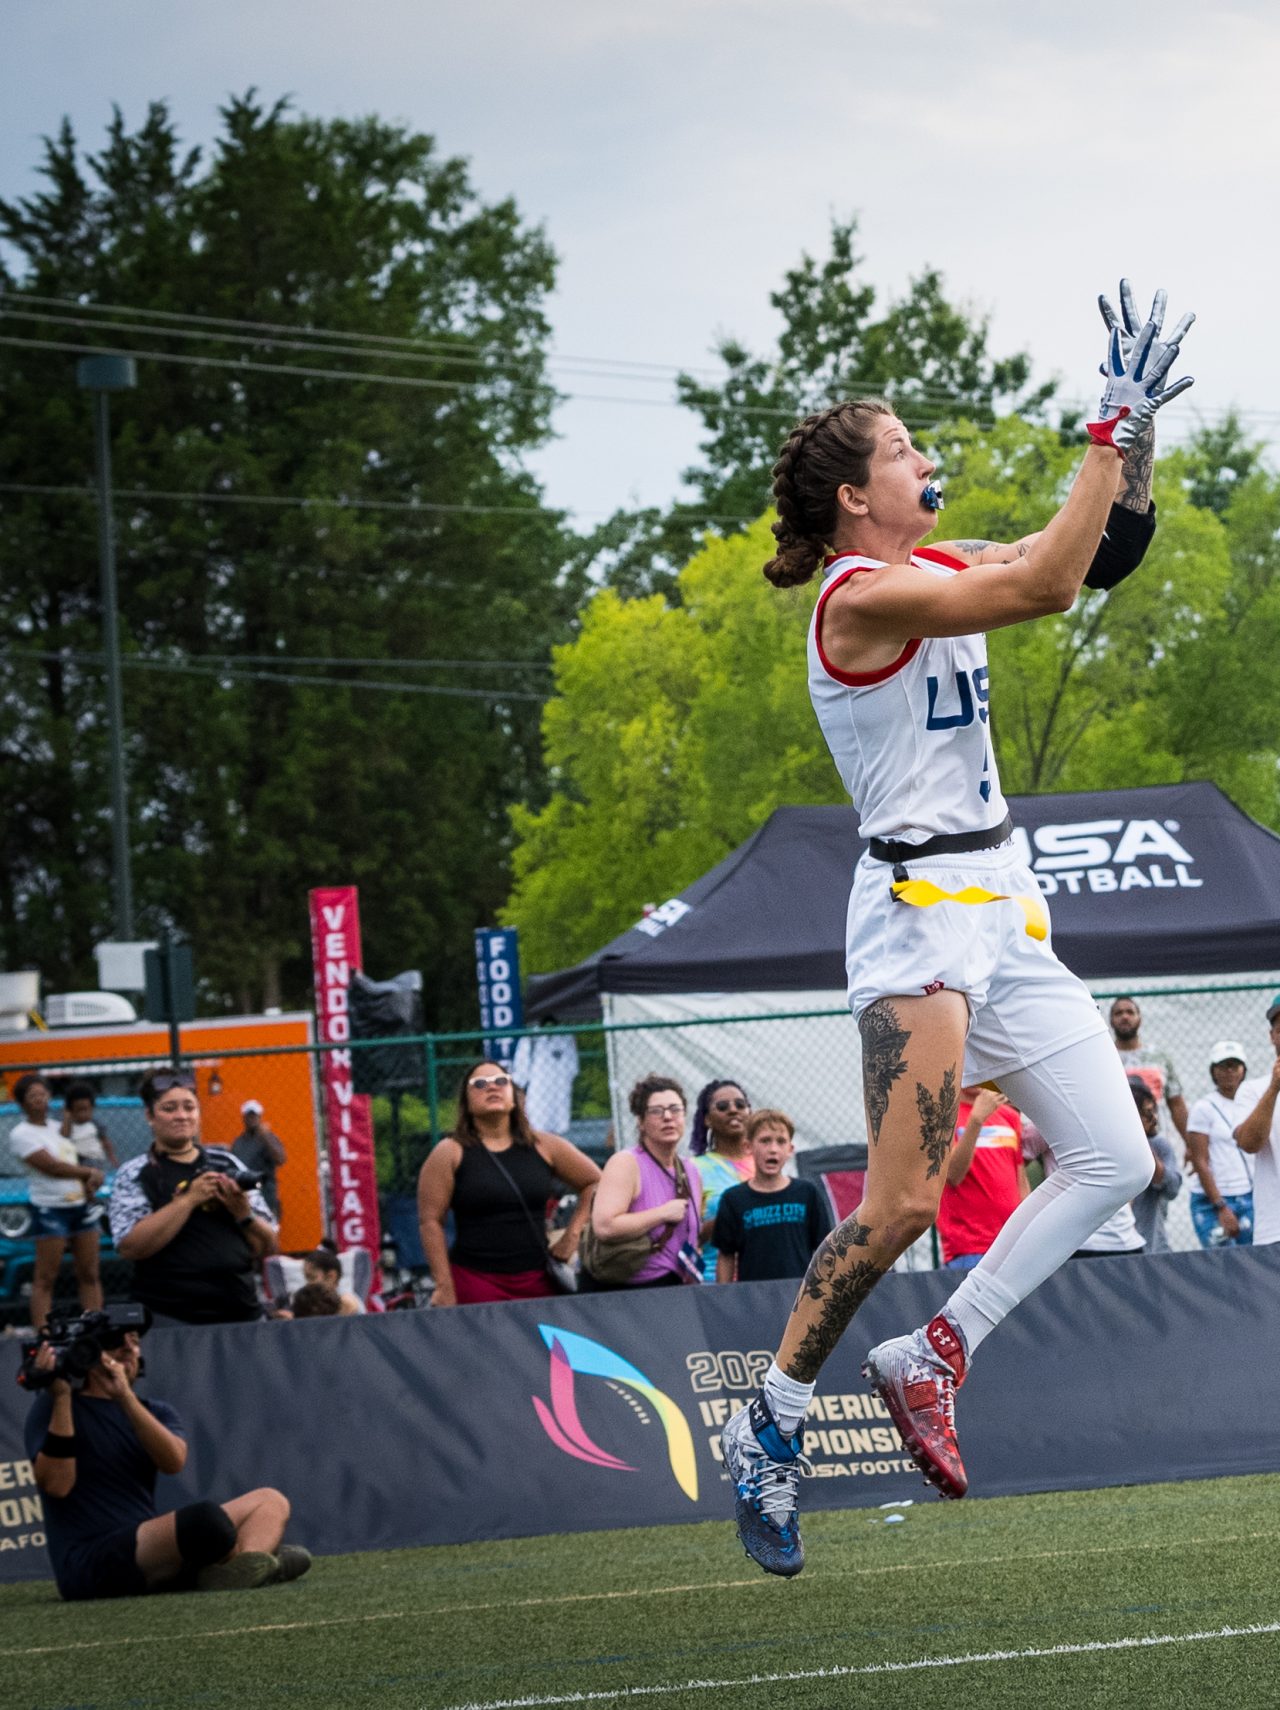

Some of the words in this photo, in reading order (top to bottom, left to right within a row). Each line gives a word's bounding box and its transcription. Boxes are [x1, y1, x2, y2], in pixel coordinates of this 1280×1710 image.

[925, 665, 990, 731] US
[1034, 863, 1204, 896] OTBALL
[321, 904, 352, 1069] VENDOR
[489, 936, 513, 1028] FOOD
[331, 1080, 366, 1250] VILLAG
[685, 1350, 777, 1393] 202
